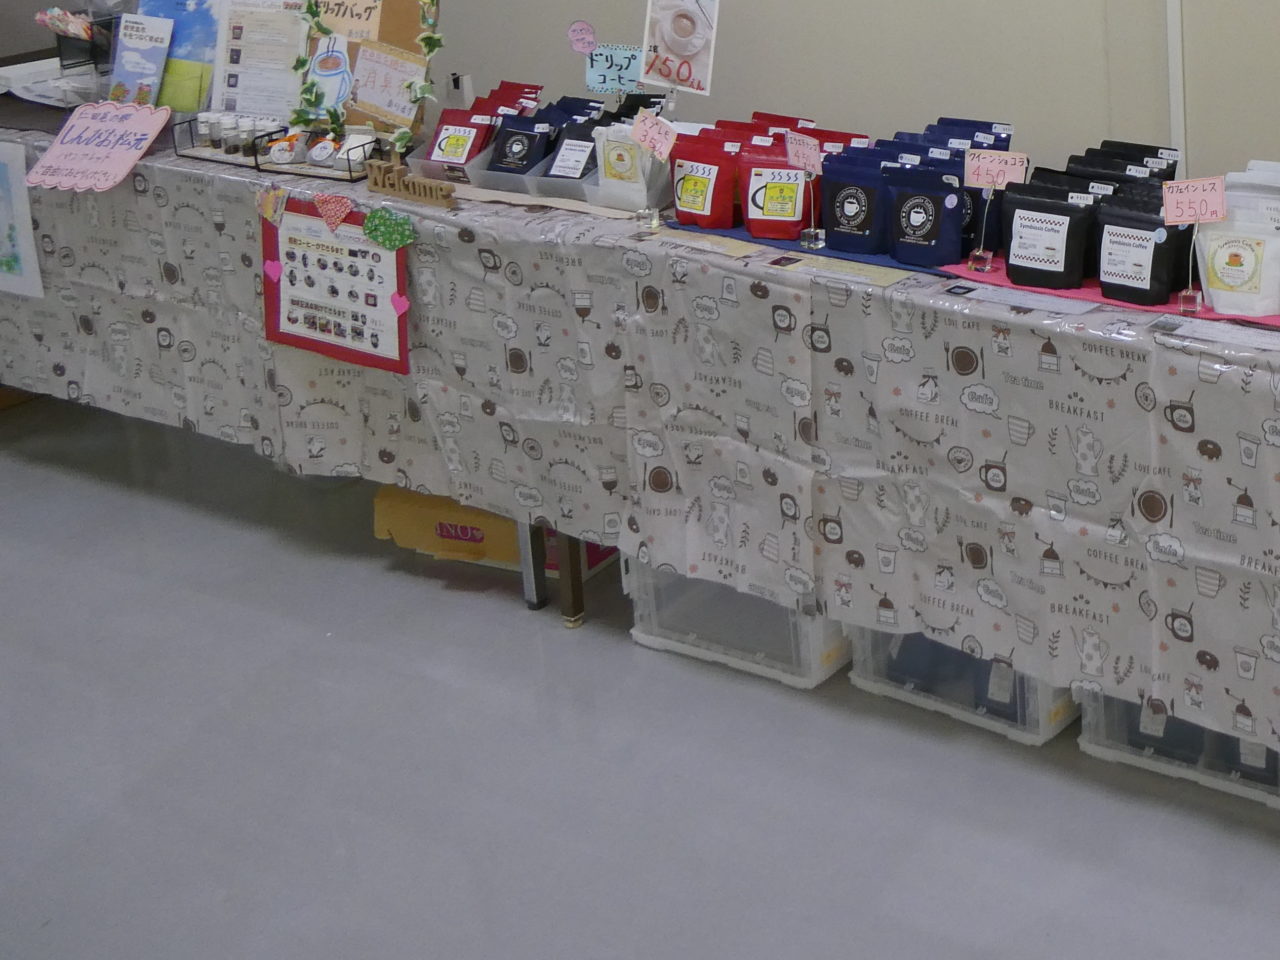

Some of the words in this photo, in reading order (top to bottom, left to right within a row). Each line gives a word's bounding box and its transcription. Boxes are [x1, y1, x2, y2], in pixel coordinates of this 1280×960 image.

[589, 51, 637, 71] ドリップ
[644, 54, 692, 82] 150
[597, 74, 638, 86] コーヒー
[60, 124, 149, 151] しんびお松元
[968, 152, 1025, 167] クイーンショコラ
[366, 160, 456, 200] Welcome
[972, 165, 1006, 186] 450
[1166, 181, 1218, 194] カフェインレス
[1174, 198, 1218, 220] 550円
[1044, 226, 1060, 234] Coffee
[1132, 242, 1148, 250] Coffee
[1082, 342, 1116, 358] COFFEE
[1119, 348, 1148, 364] BREAK
[967, 391, 994, 407] Cafe
[900, 408, 931, 422] COFFEE
[1048, 399, 1105, 423] BREAKFAST
[1152, 466, 1172, 478] CAFE
[1087, 547, 1119, 565] COFFEE
[950, 603, 975, 618] BREAK
[1050, 602, 1110, 625] BREAKFAST
